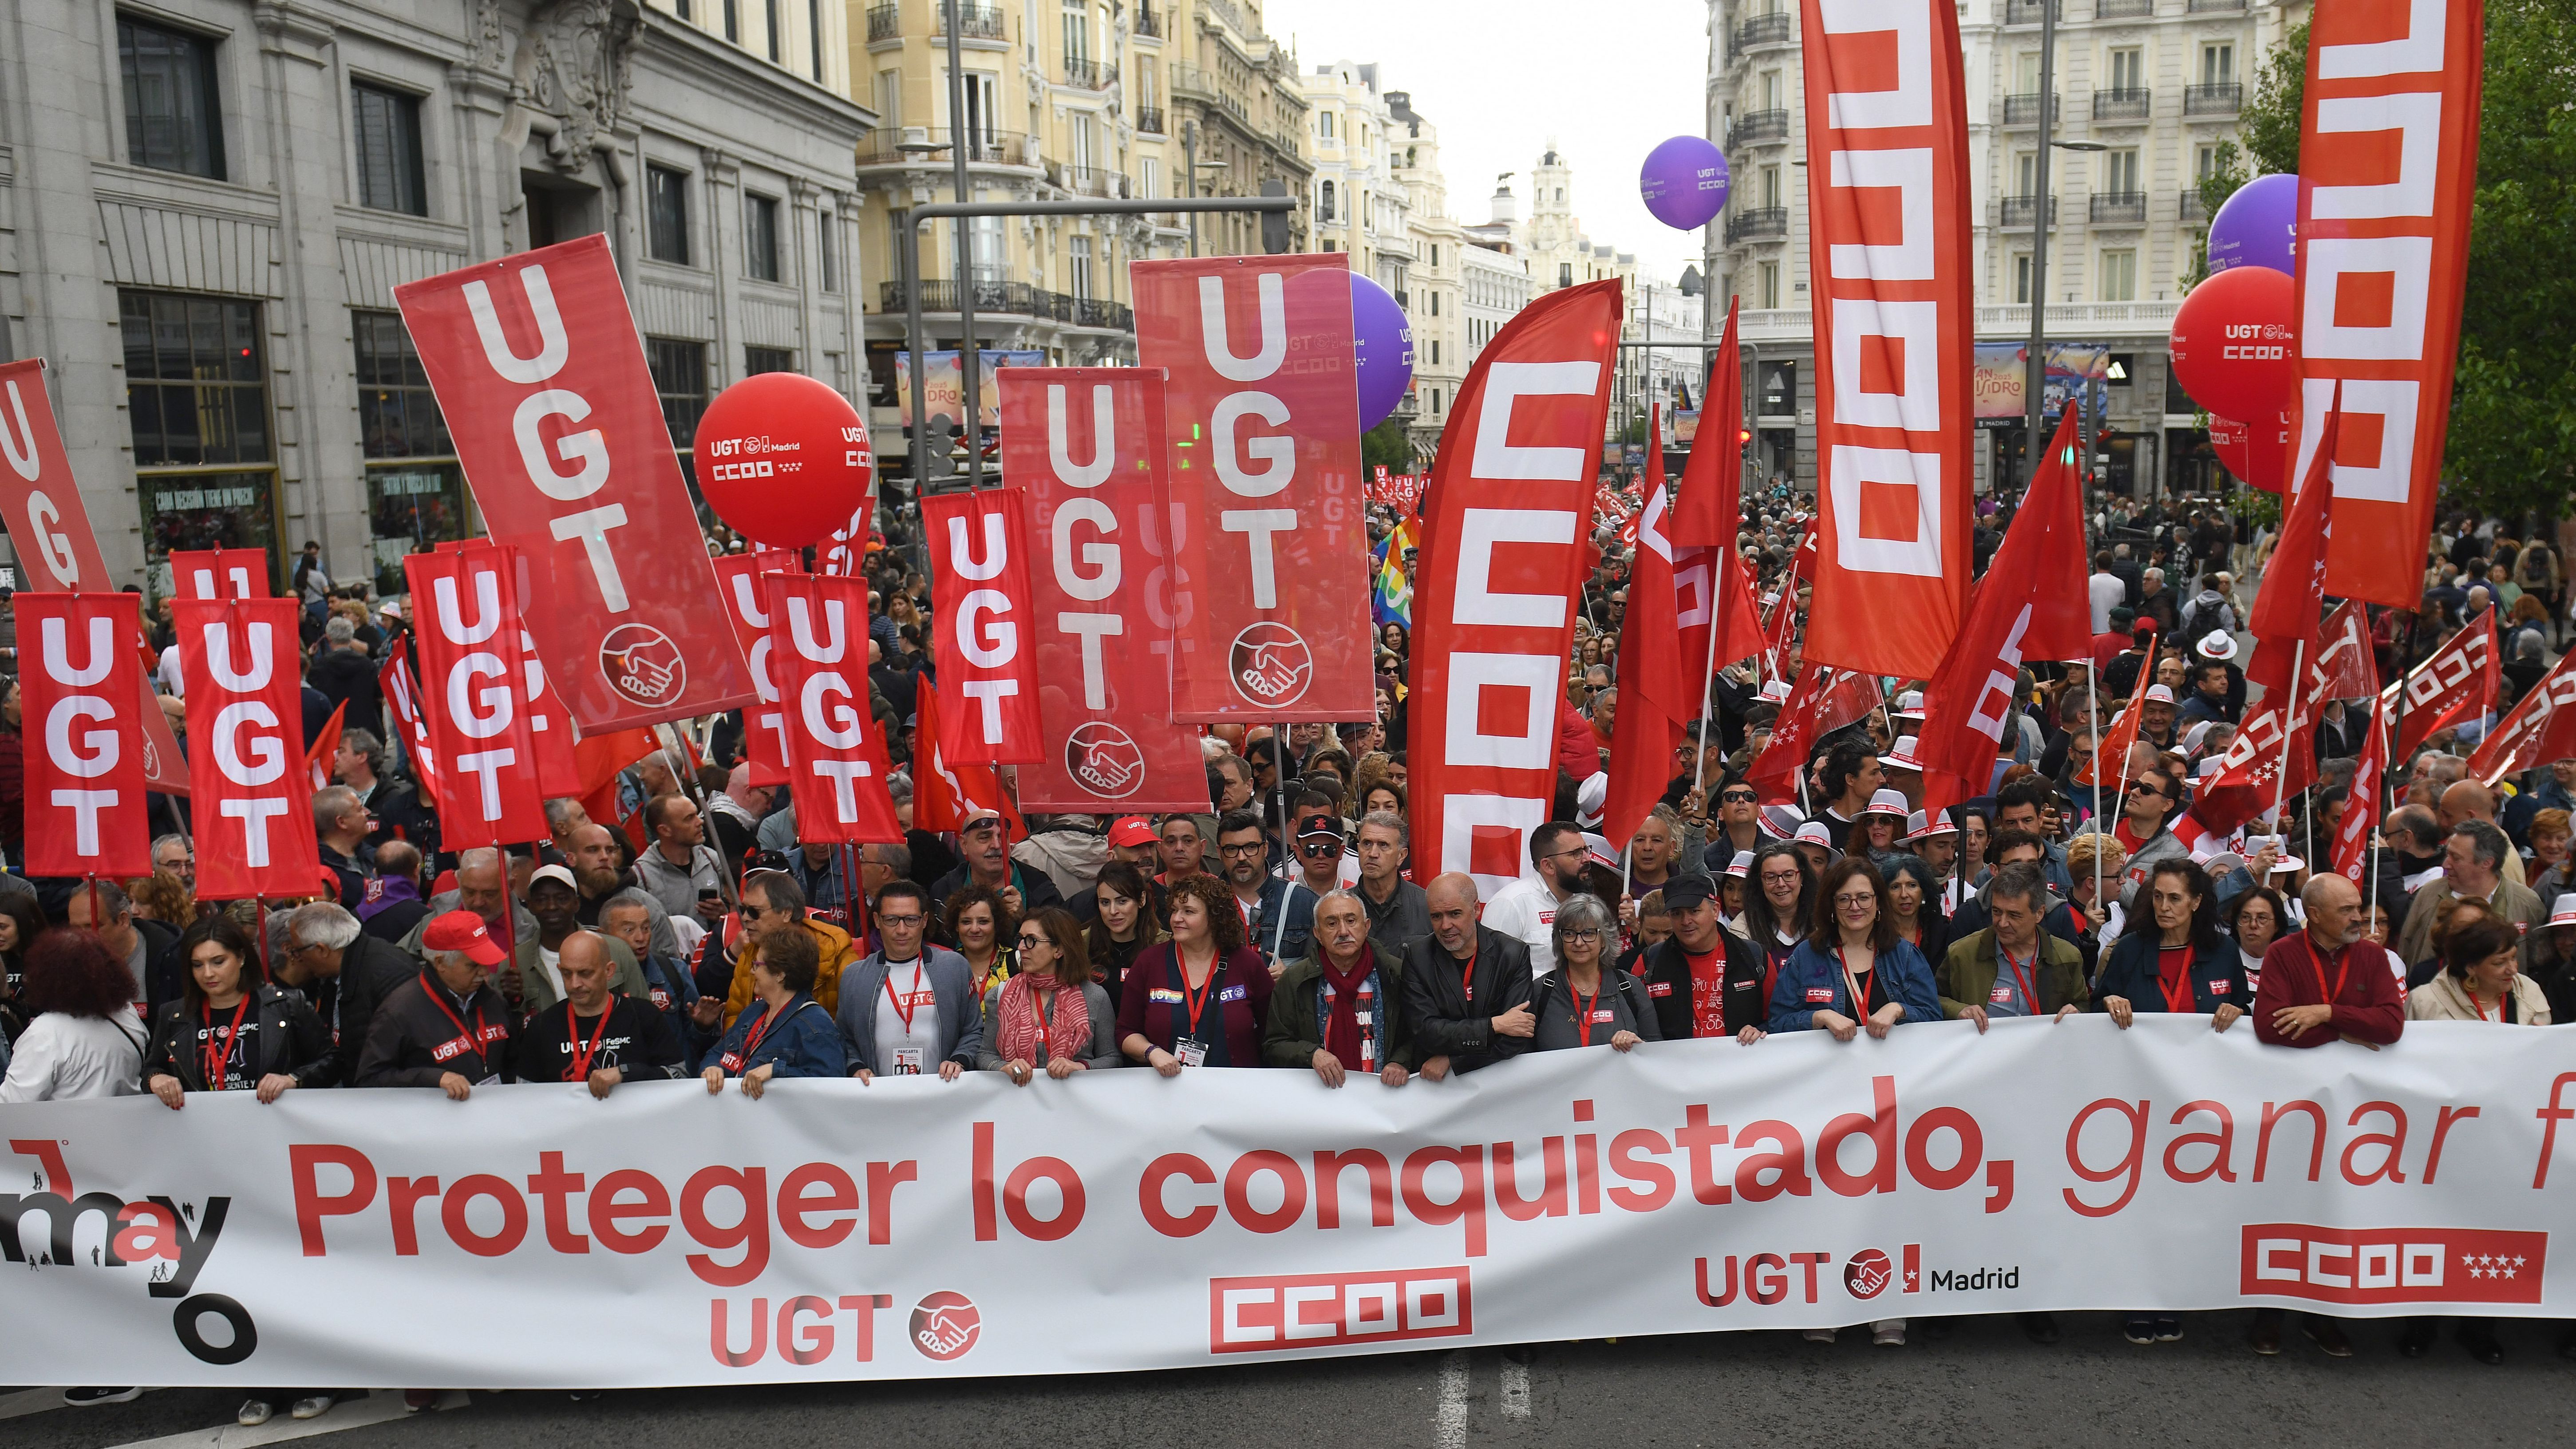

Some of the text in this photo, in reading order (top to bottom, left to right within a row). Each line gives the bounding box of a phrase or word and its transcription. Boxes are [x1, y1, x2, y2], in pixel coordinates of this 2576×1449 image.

[1698, 168, 1715, 178] UGT
[1699, 179, 1726, 190] CCOO
[1400, 328, 1412, 343] UG
[2226, 325, 2262, 339] UGT
[2224, 346, 2284, 360] CCOO
[1975, 369, 1993, 378] AN
[1976, 378, 2021, 396] ISIDRO
[928, 390, 957, 404] DRO
[461, 264, 629, 614] UGT
[711, 438, 800, 457] UGT Madrid
[1198, 273, 1297, 609] UGT
[845, 450, 871, 467] CCO
[712, 461, 774, 482] CCOO
[1376, 468, 1386, 488] UG
[0, 380, 79, 589] UG
[1404, 478, 1414, 502] UG
[1047, 384, 1123, 710] UGT
[948, 513, 1018, 744] UGT
[1440, 361, 1601, 906] CCOO
[433, 570, 516, 821] UGT
[786, 597, 871, 823] UGT
[41, 617, 120, 857] UGT
[203, 622, 289, 868] UGT
[7, 974, 21, 983] GT
[1648, 983, 1670, 992] CCOO
[1151, 990, 1171, 1000] UGT
[202, 1023, 257, 1040] GT eSMC
[606, 1036, 631, 1047] FeSMC
[1181, 1046, 1201, 1055] PANCARTA
[433, 1042, 457, 1060] UGT
[723, 1052, 737, 1066] UGT
[212, 1073, 241, 1084] PADO
[250, 1079, 256, 1088] Y
[288, 1143, 917, 1287] Proteger
[972, 1121, 1086, 1241] lo
[1138, 1075, 2014, 1257] conquistado,
[2062, 1098, 2481, 1218] ganar
[2256, 1239, 2446, 1289] CCOO
[1695, 1252, 2019, 1307] UGT Madrid
[1223, 1280, 1459, 1343] CCOO
[711, 1294, 893, 1368] UGT
